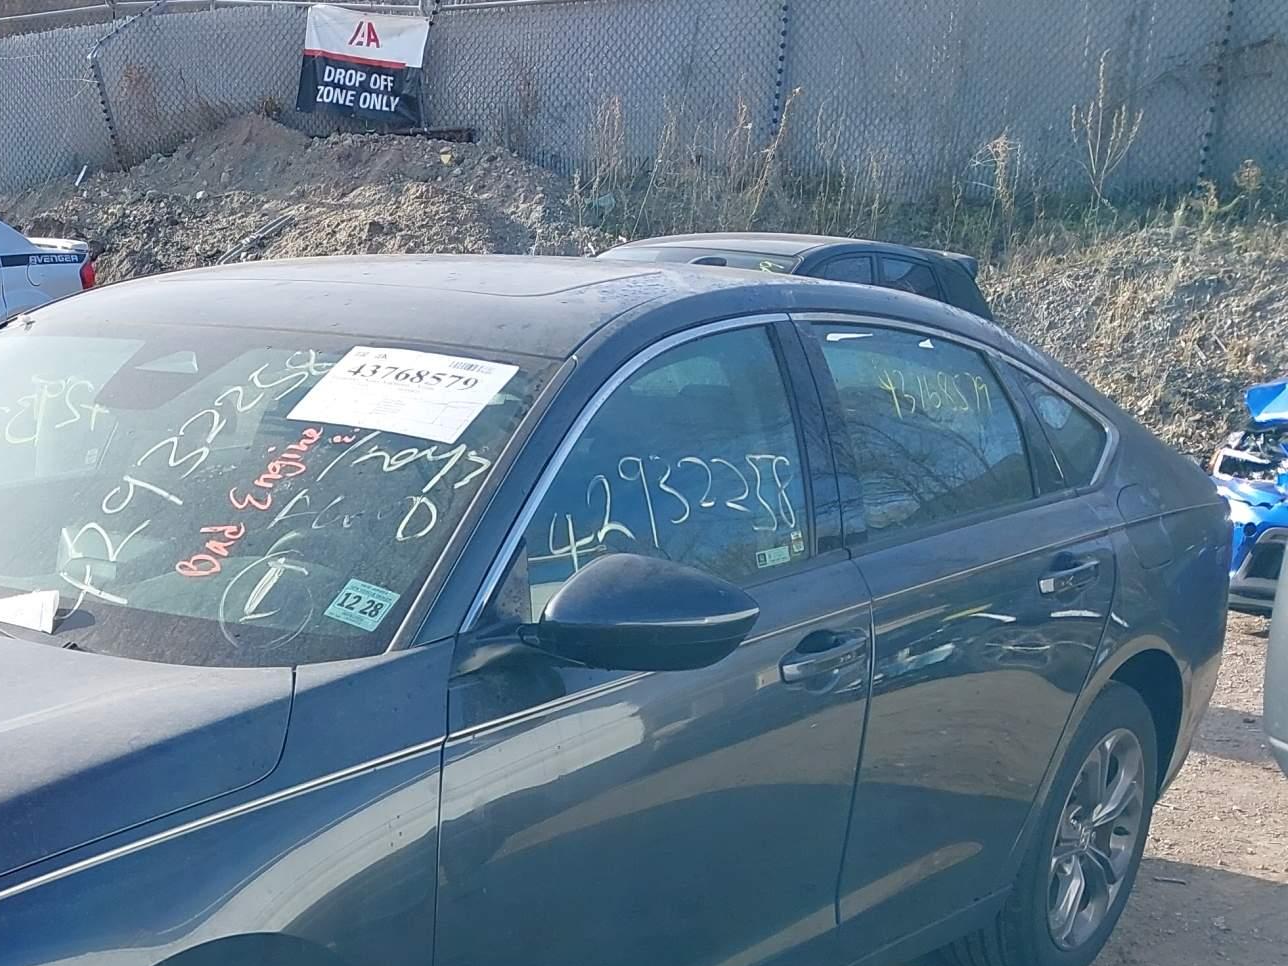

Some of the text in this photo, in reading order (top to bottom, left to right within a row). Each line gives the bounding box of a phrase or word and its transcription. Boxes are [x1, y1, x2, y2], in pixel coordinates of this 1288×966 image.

[323, 65, 394, 92] DROP OFF
[316, 85, 400, 112] ZONE ONLY
[28, 254, 79, 265] AVENGER
[347, 362, 479, 391] 43768579
[175, 425, 325, 578] Bad Engine
[336, 591, 362, 611] 12
[358, 598, 384, 619] 28
